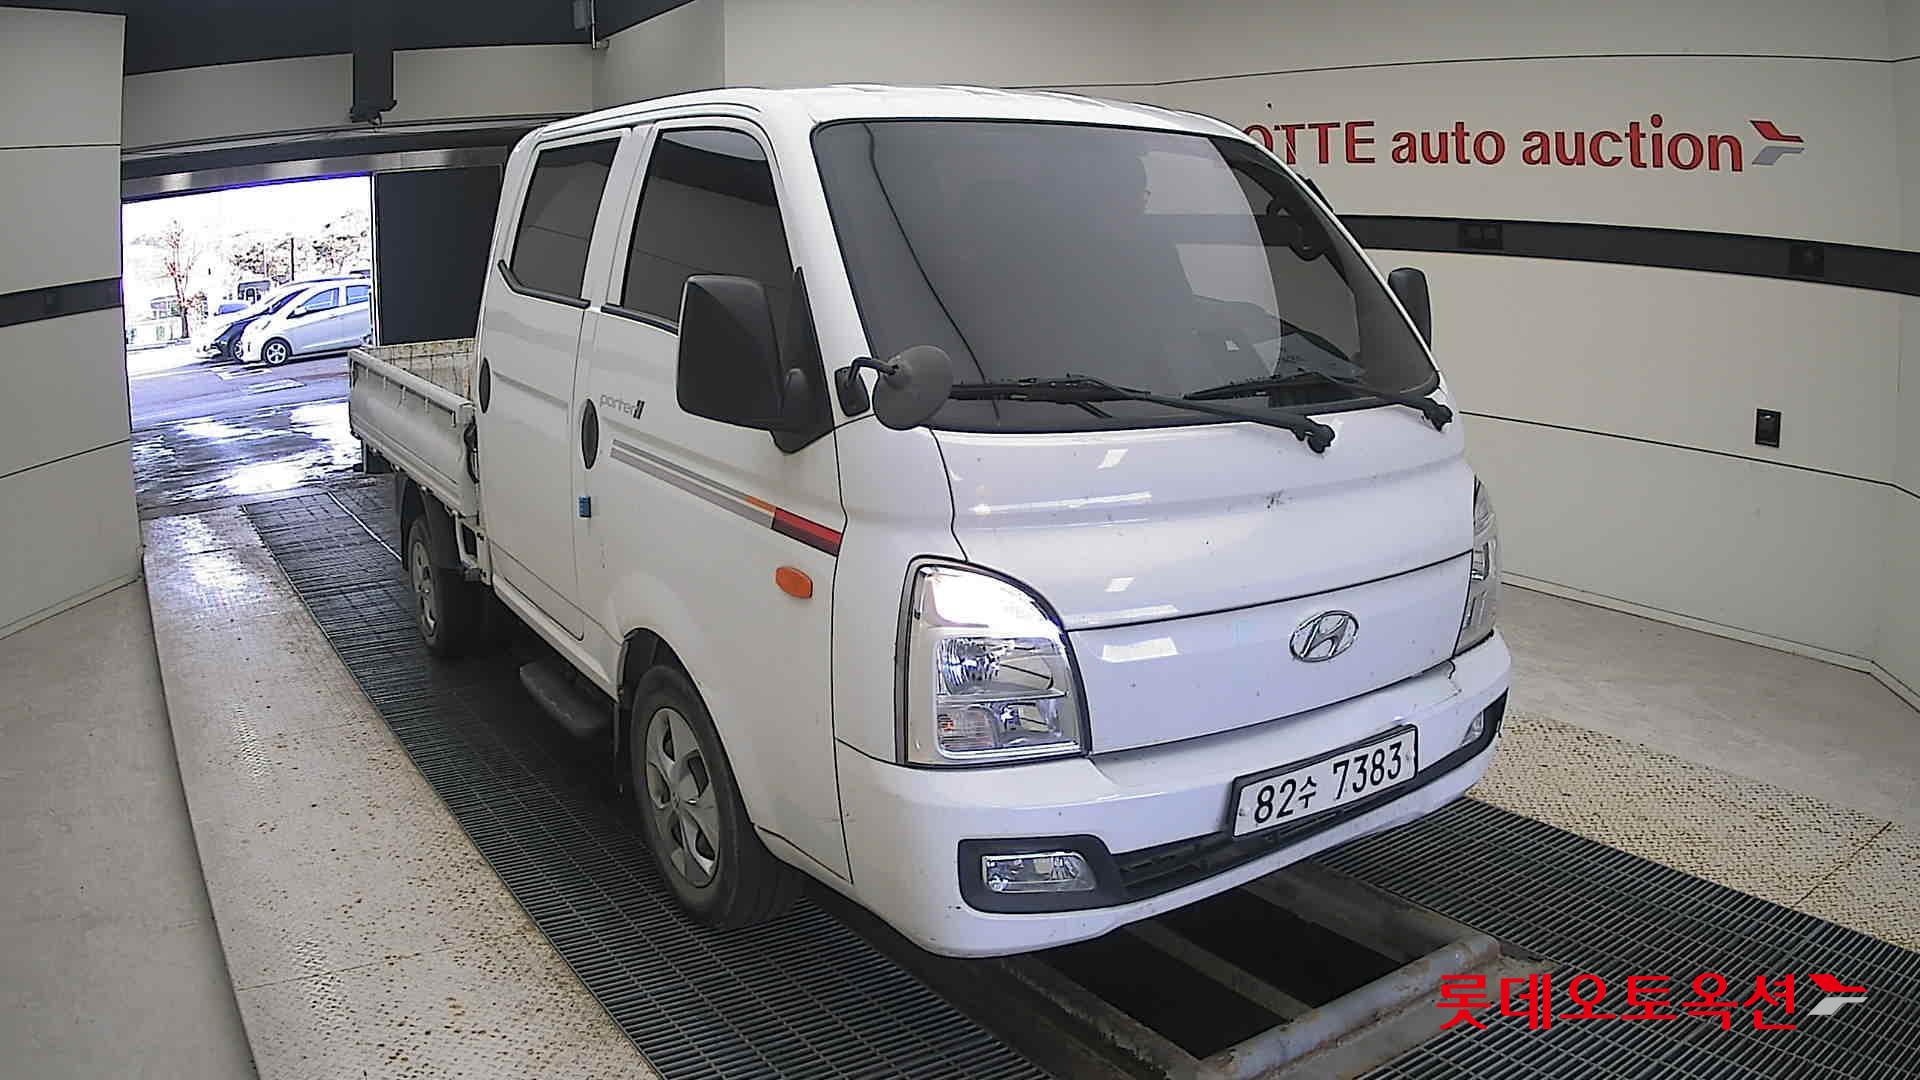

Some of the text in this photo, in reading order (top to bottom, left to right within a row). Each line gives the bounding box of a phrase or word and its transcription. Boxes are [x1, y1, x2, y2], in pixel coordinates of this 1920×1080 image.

[1242, 114, 1743, 172] OTTE auto auction
[1254, 741, 1402, 824] 82수 7383
